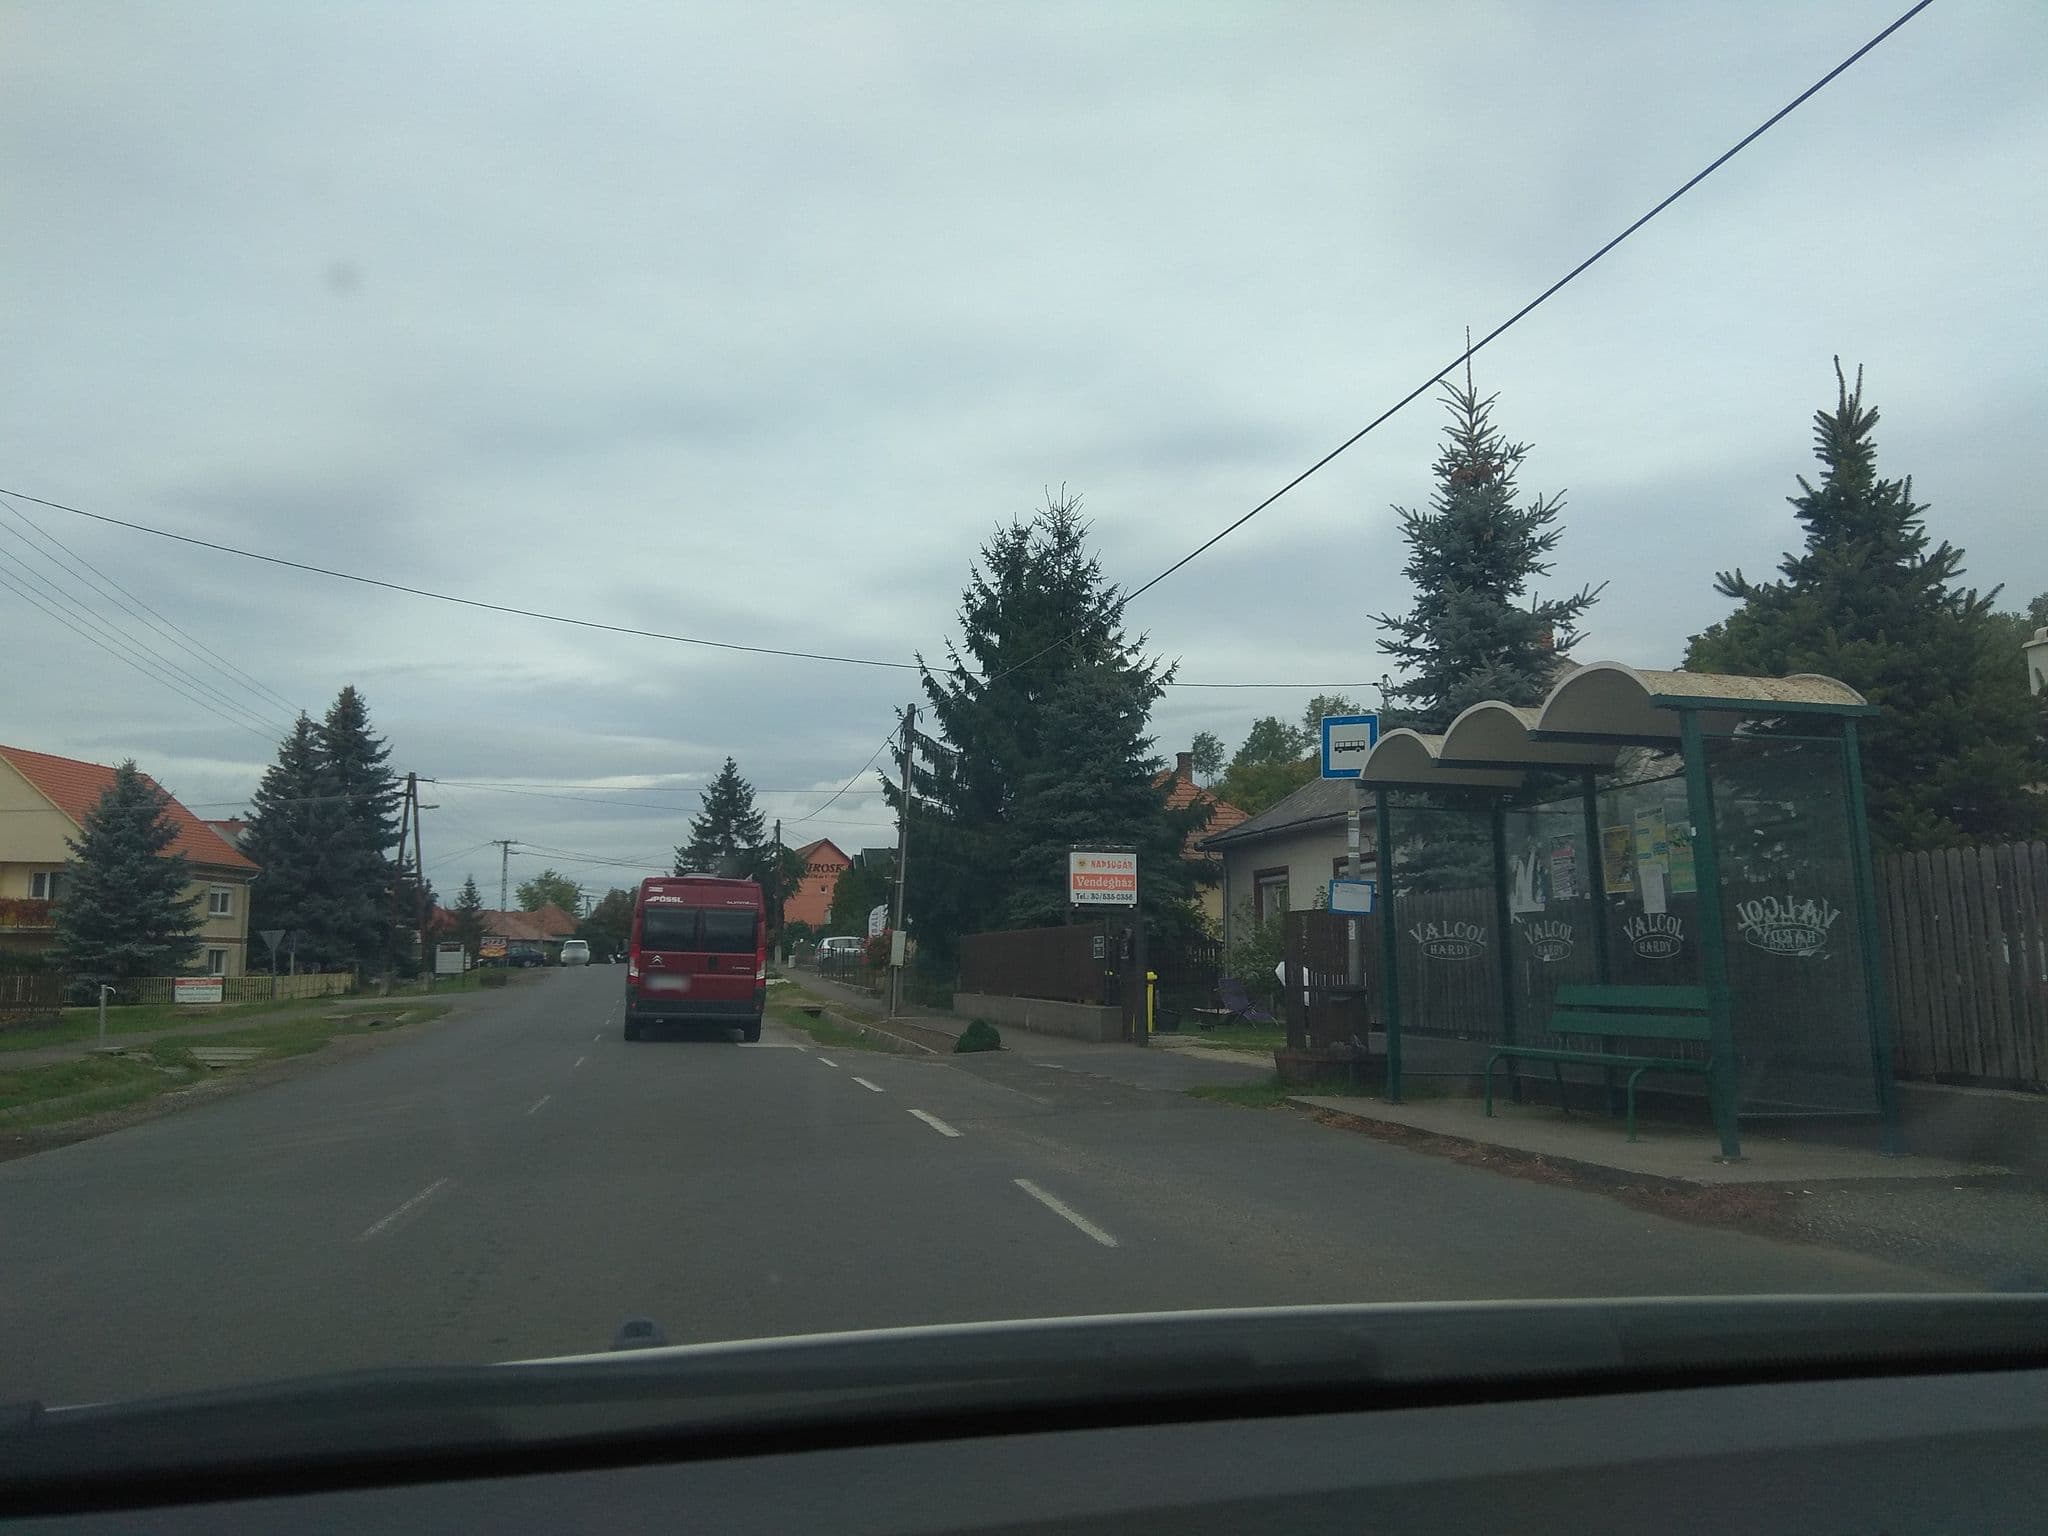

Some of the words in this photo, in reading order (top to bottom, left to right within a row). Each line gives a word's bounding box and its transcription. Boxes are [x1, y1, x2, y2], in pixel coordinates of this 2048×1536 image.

[1409, 920, 1488, 947] VALCOL
[1525, 920, 1575, 945] VALCOL
[1623, 913, 1684, 941] VALCOL
[1430, 945, 1472, 955] HARDY
[1639, 940, 1673, 953] HARDY
